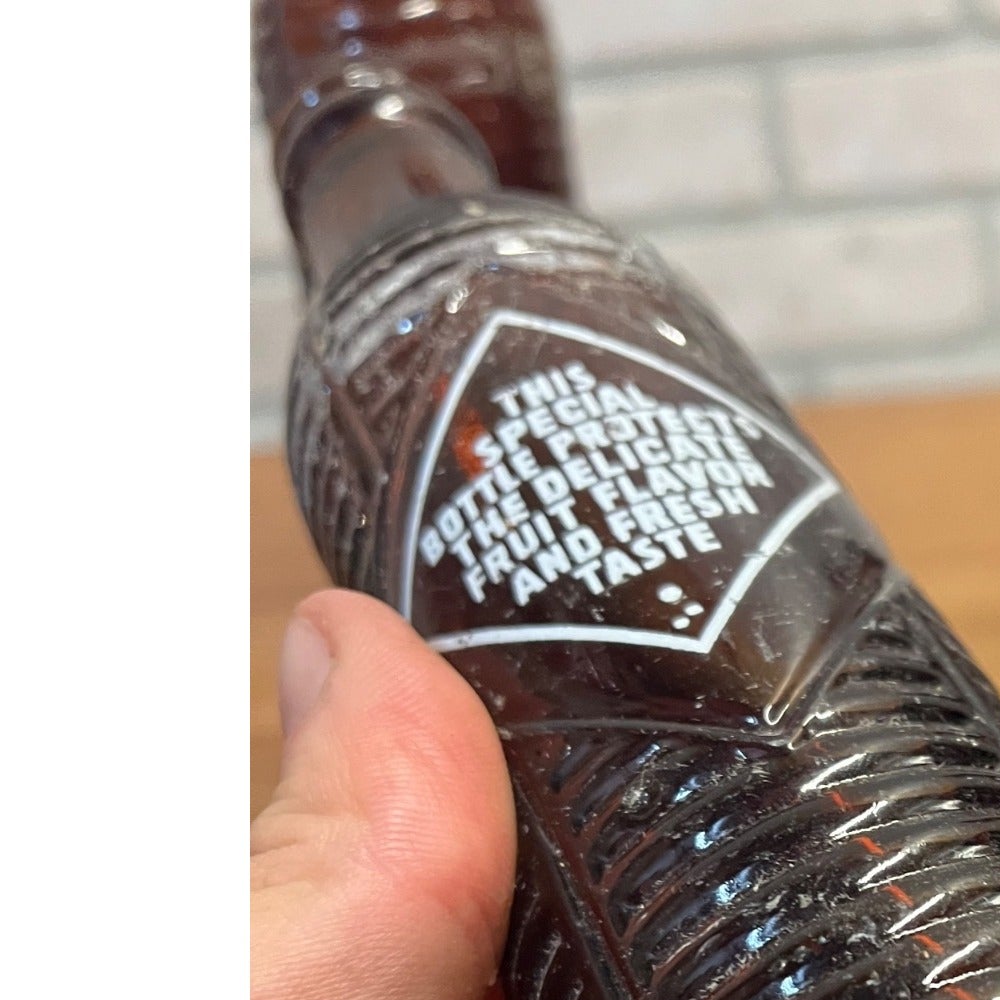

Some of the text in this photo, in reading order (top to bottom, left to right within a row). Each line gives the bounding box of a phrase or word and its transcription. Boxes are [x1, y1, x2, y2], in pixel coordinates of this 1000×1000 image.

[473, 382, 658, 469] SPECIAL
[492, 363, 597, 418] THIS
[420, 405, 763, 568] BOTTLE PROTECTS
[451, 428, 755, 569] THE DELICATE
[463, 457, 775, 604] FRUIT FLAVOR
[511, 485, 761, 607] AND FRESH
[571, 520, 723, 596] TASTE
